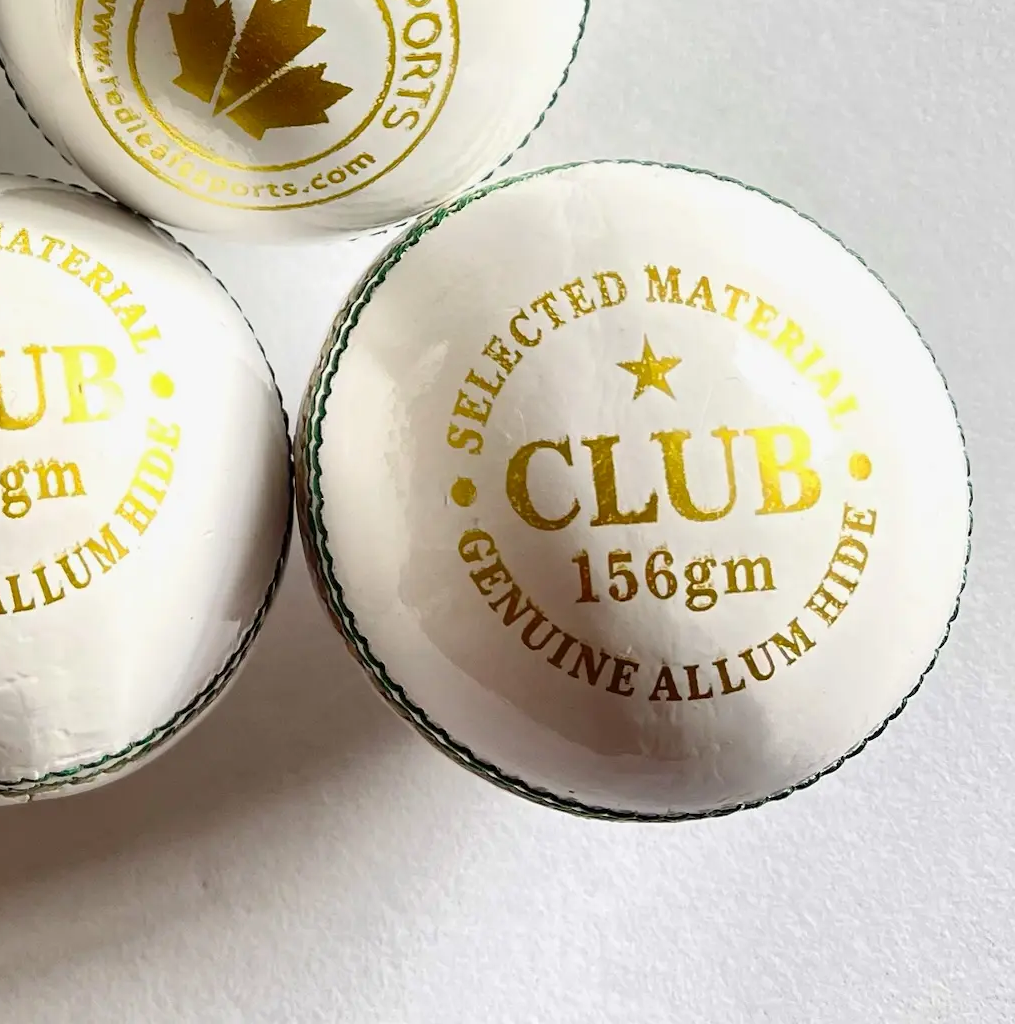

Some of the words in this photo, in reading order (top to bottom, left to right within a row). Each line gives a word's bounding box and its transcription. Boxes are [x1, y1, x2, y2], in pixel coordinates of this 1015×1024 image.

[446, 270, 628, 456] SELECTED
[643, 264, 859, 430] MATERIAL
[114, 416, 181, 536] HIDE
[505, 425, 822, 532] CLUB
[457, 527, 640, 697] GENUINE
[648, 616, 817, 702] ALLUM
[803, 502, 878, 629] HIDE
[572, 546, 777, 612] 156gm
